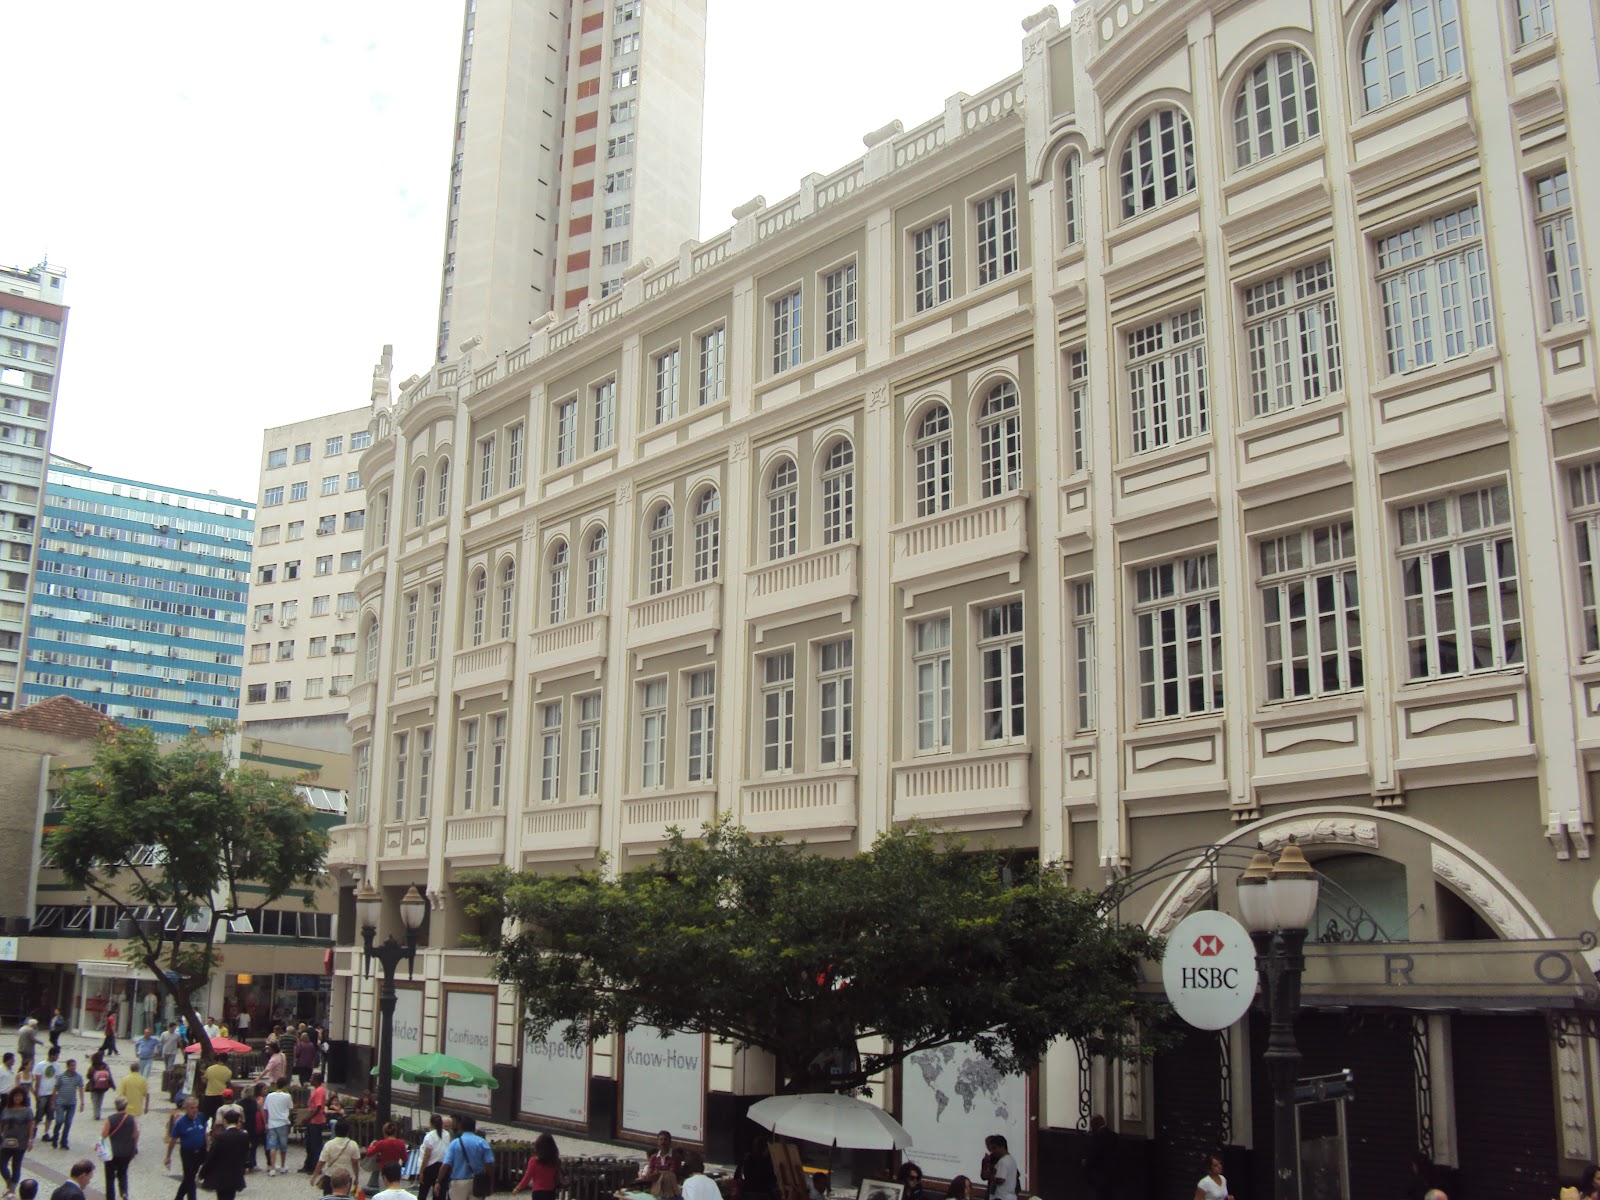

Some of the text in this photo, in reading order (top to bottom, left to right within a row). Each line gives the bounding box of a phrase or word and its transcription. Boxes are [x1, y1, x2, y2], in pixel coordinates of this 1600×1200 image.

[1182, 967, 1239, 989] HSBC
[391, 1020, 418, 1042] lidez
[448, 1027, 489, 1049] Confiança
[626, 1045, 698, 1071] Know-How
